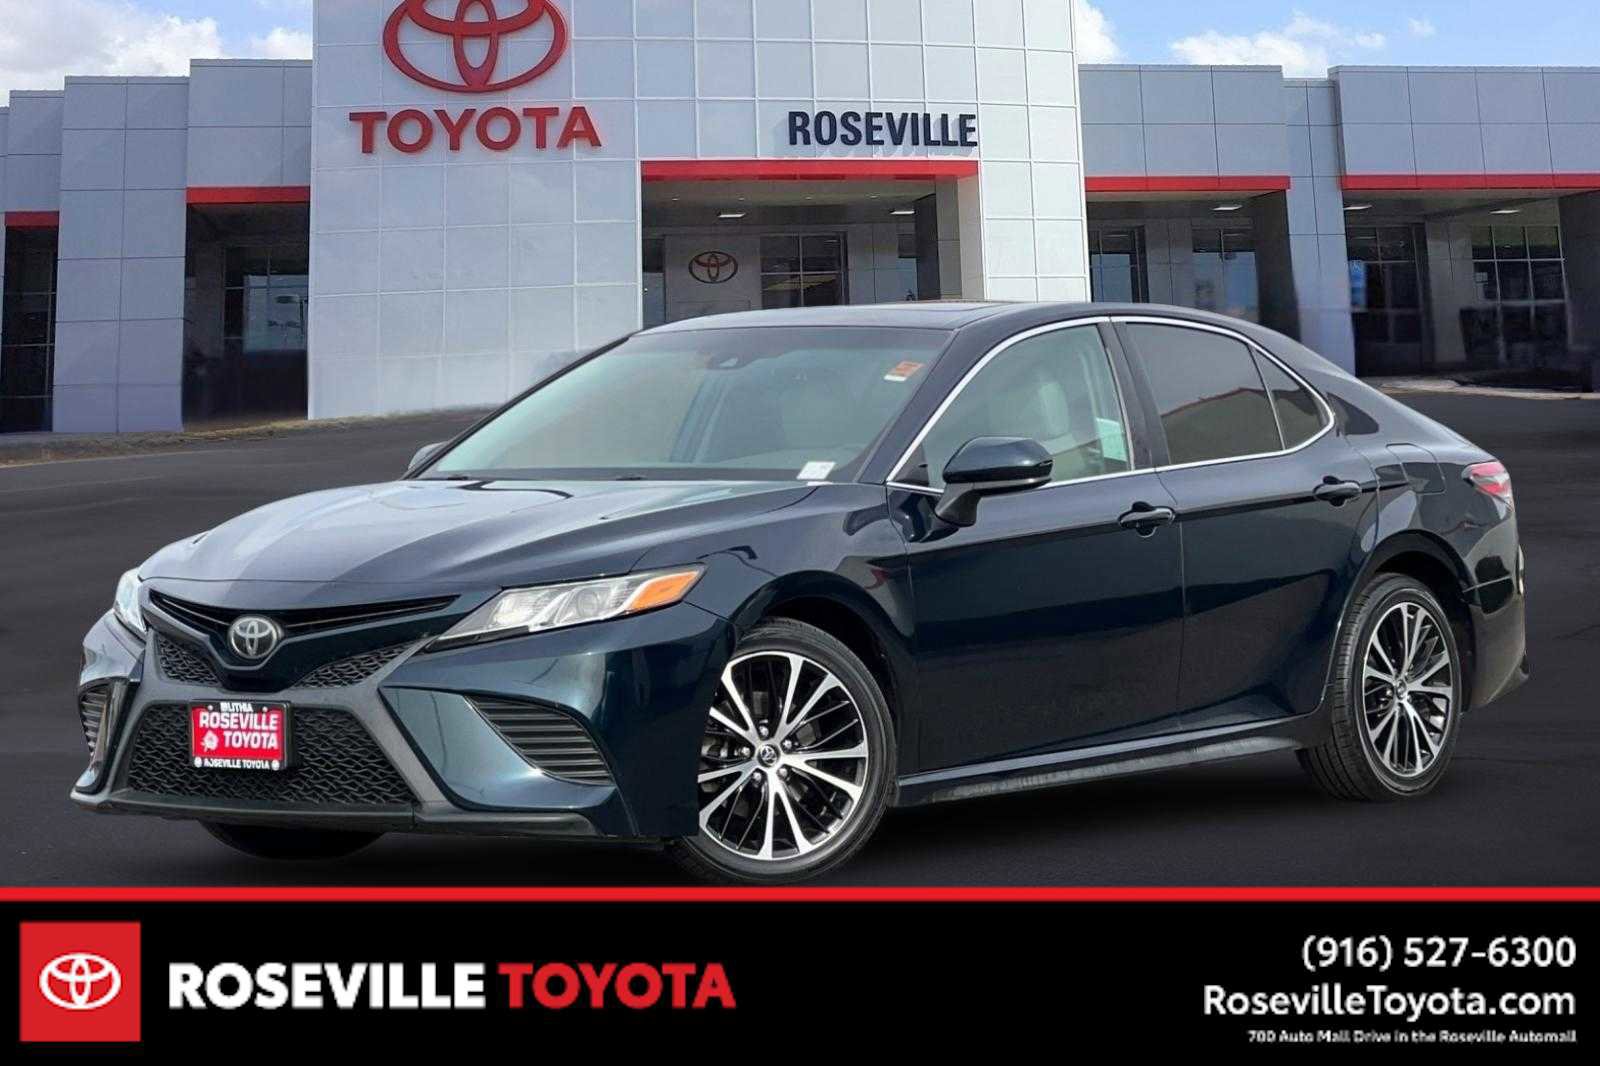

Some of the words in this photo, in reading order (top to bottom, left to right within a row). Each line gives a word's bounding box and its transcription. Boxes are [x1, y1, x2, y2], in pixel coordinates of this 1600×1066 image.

[350, 106, 602, 153] TOYOTA
[789, 111, 978, 146] ROSEVILLE
[200, 711, 279, 731] ROSEVILLE
[223, 731, 279, 750] TOYOTA
